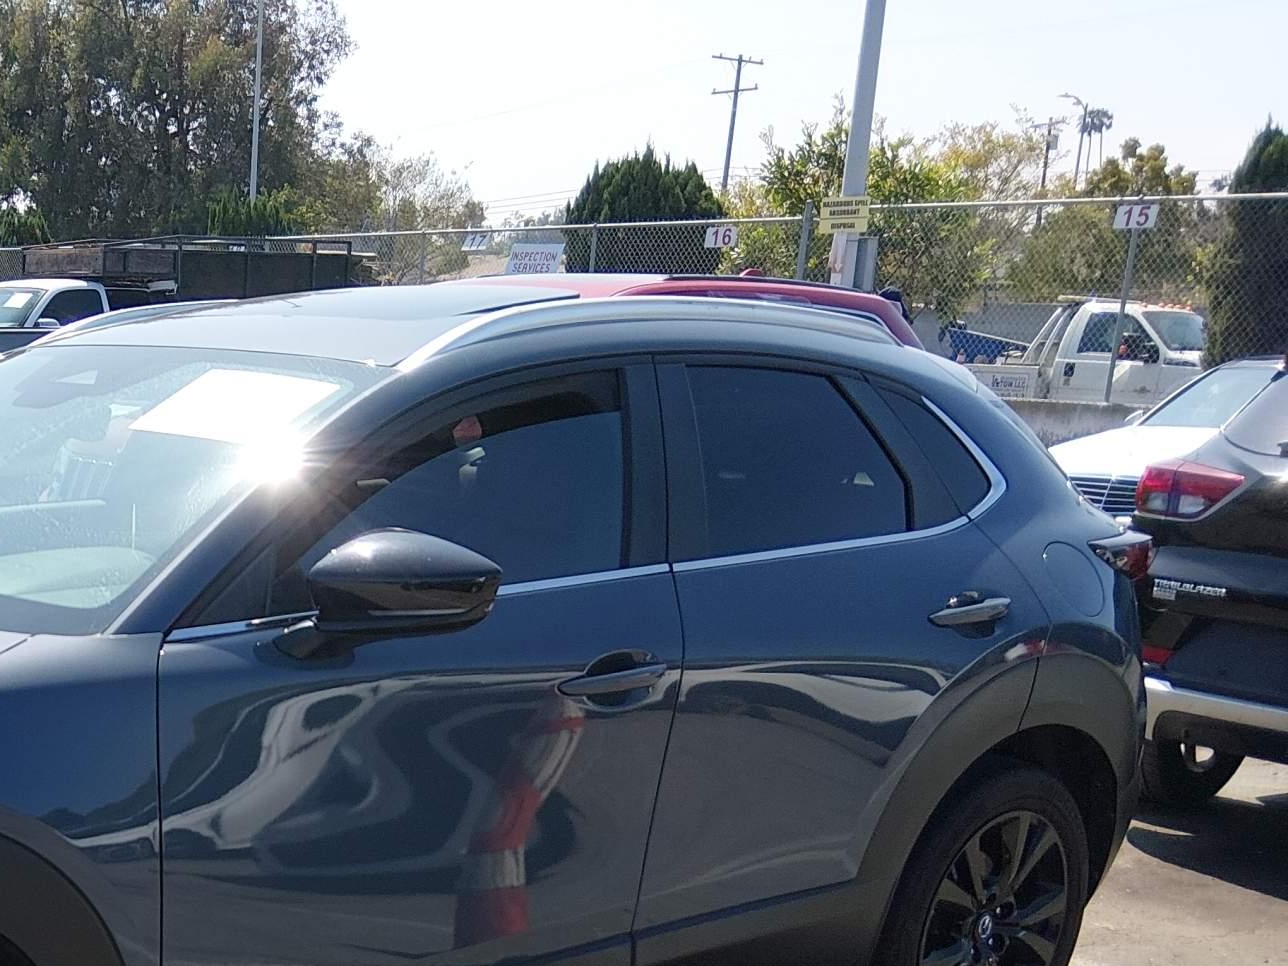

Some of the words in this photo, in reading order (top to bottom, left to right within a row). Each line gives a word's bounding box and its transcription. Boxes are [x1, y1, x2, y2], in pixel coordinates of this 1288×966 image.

[1123, 205, 1151, 227] 15
[469, 234, 487, 249] 17
[712, 228, 732, 246] 16
[511, 251, 558, 262] INSPECTION
[512, 262, 551, 273] SERVICES
[1153, 579, 1227, 597] TRAILBLAZER
